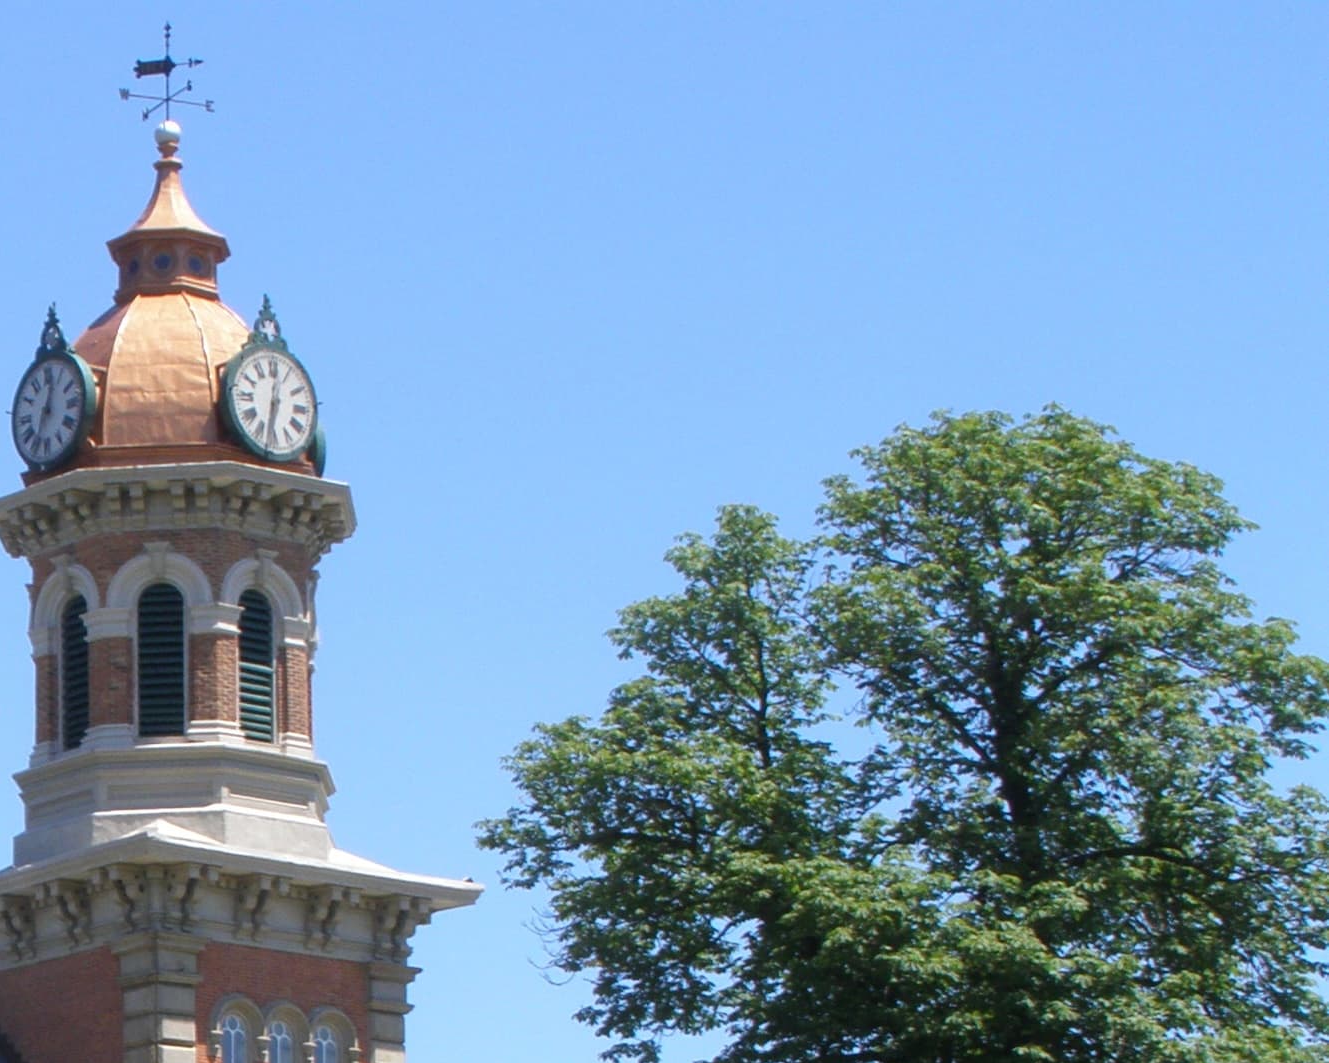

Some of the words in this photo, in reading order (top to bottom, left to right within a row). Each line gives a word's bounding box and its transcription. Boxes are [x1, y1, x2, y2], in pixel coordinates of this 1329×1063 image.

[119, 88, 129, 100] W
[206, 100, 215, 112] E
[57, 367, 63, 384] I
[254, 361, 265, 379] XI
[269, 359, 278, 378] XII
[282, 366, 292, 383] I
[239, 372, 257, 389] X
[283, 426, 293, 443] V
